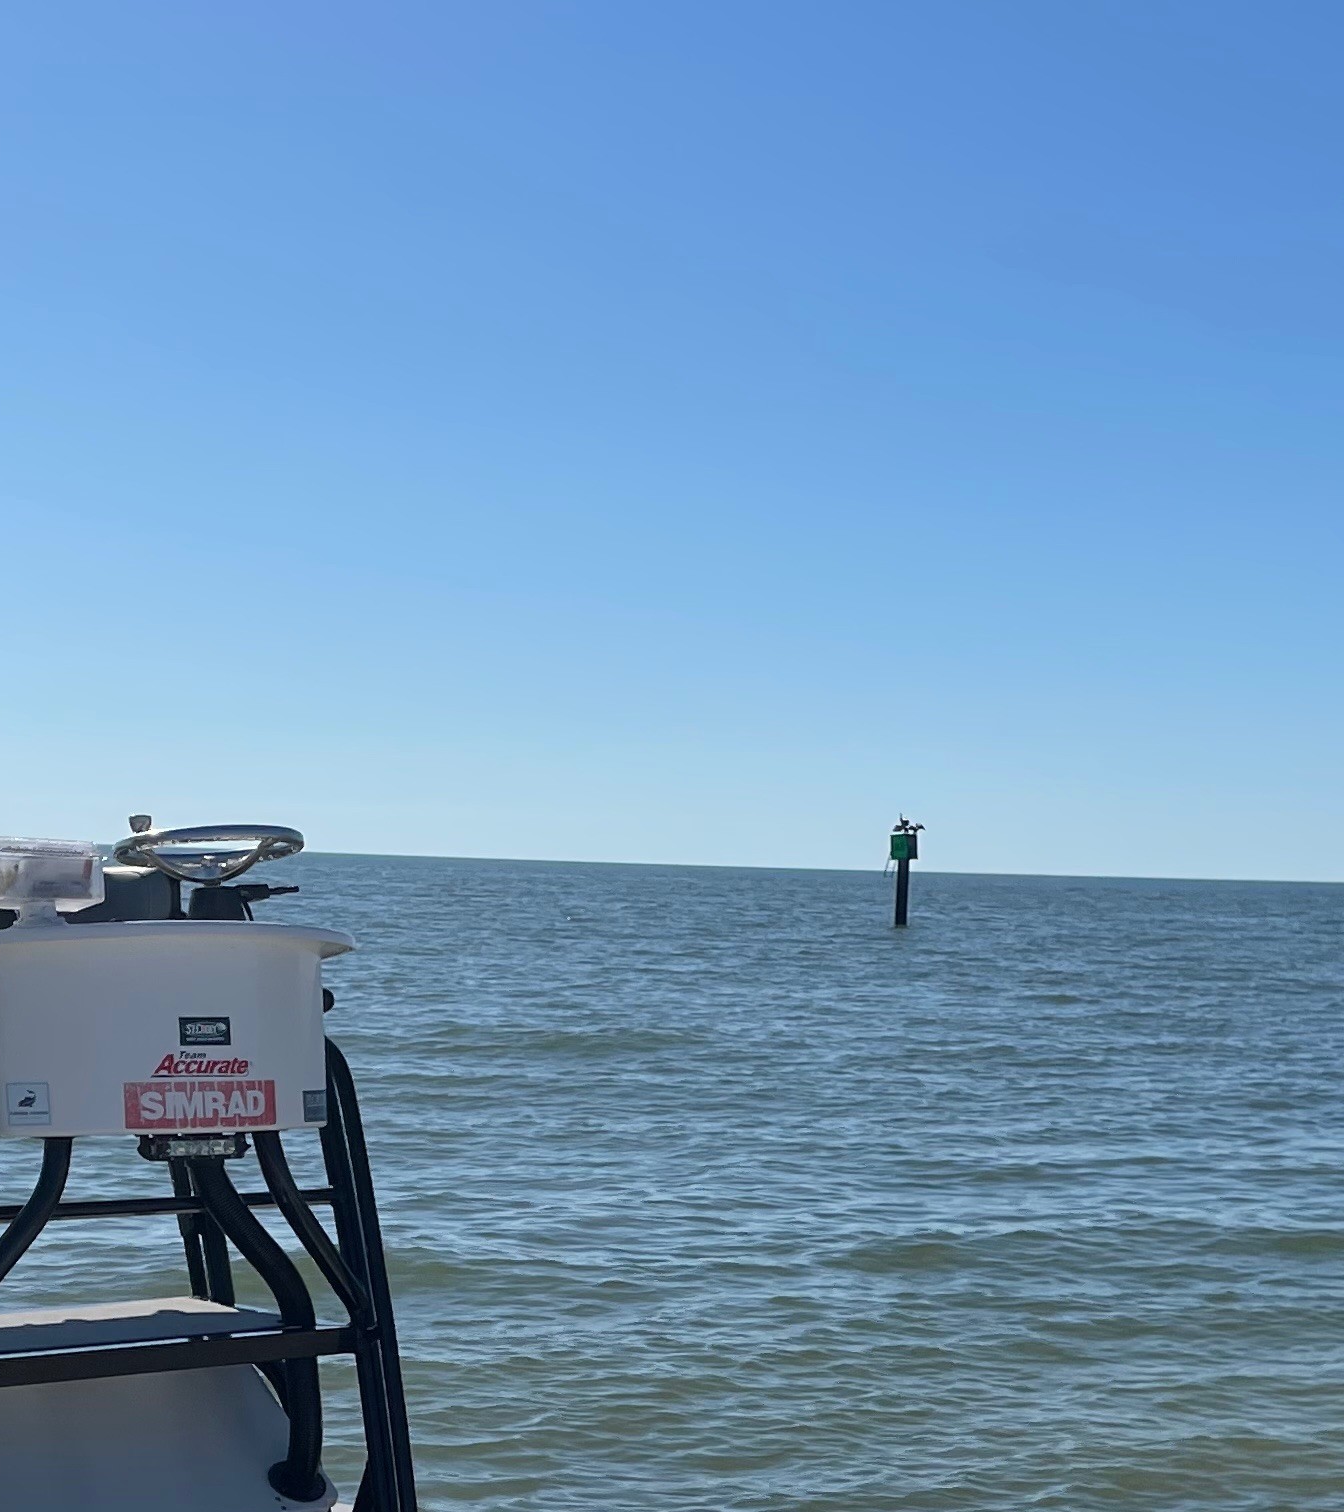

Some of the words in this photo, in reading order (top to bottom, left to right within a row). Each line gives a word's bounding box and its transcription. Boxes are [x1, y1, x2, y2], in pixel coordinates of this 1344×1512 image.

[154, 1053, 249, 1075] Accurate
[180, 1051, 206, 1059] Team
[140, 1090, 265, 1120] SIMRAD
